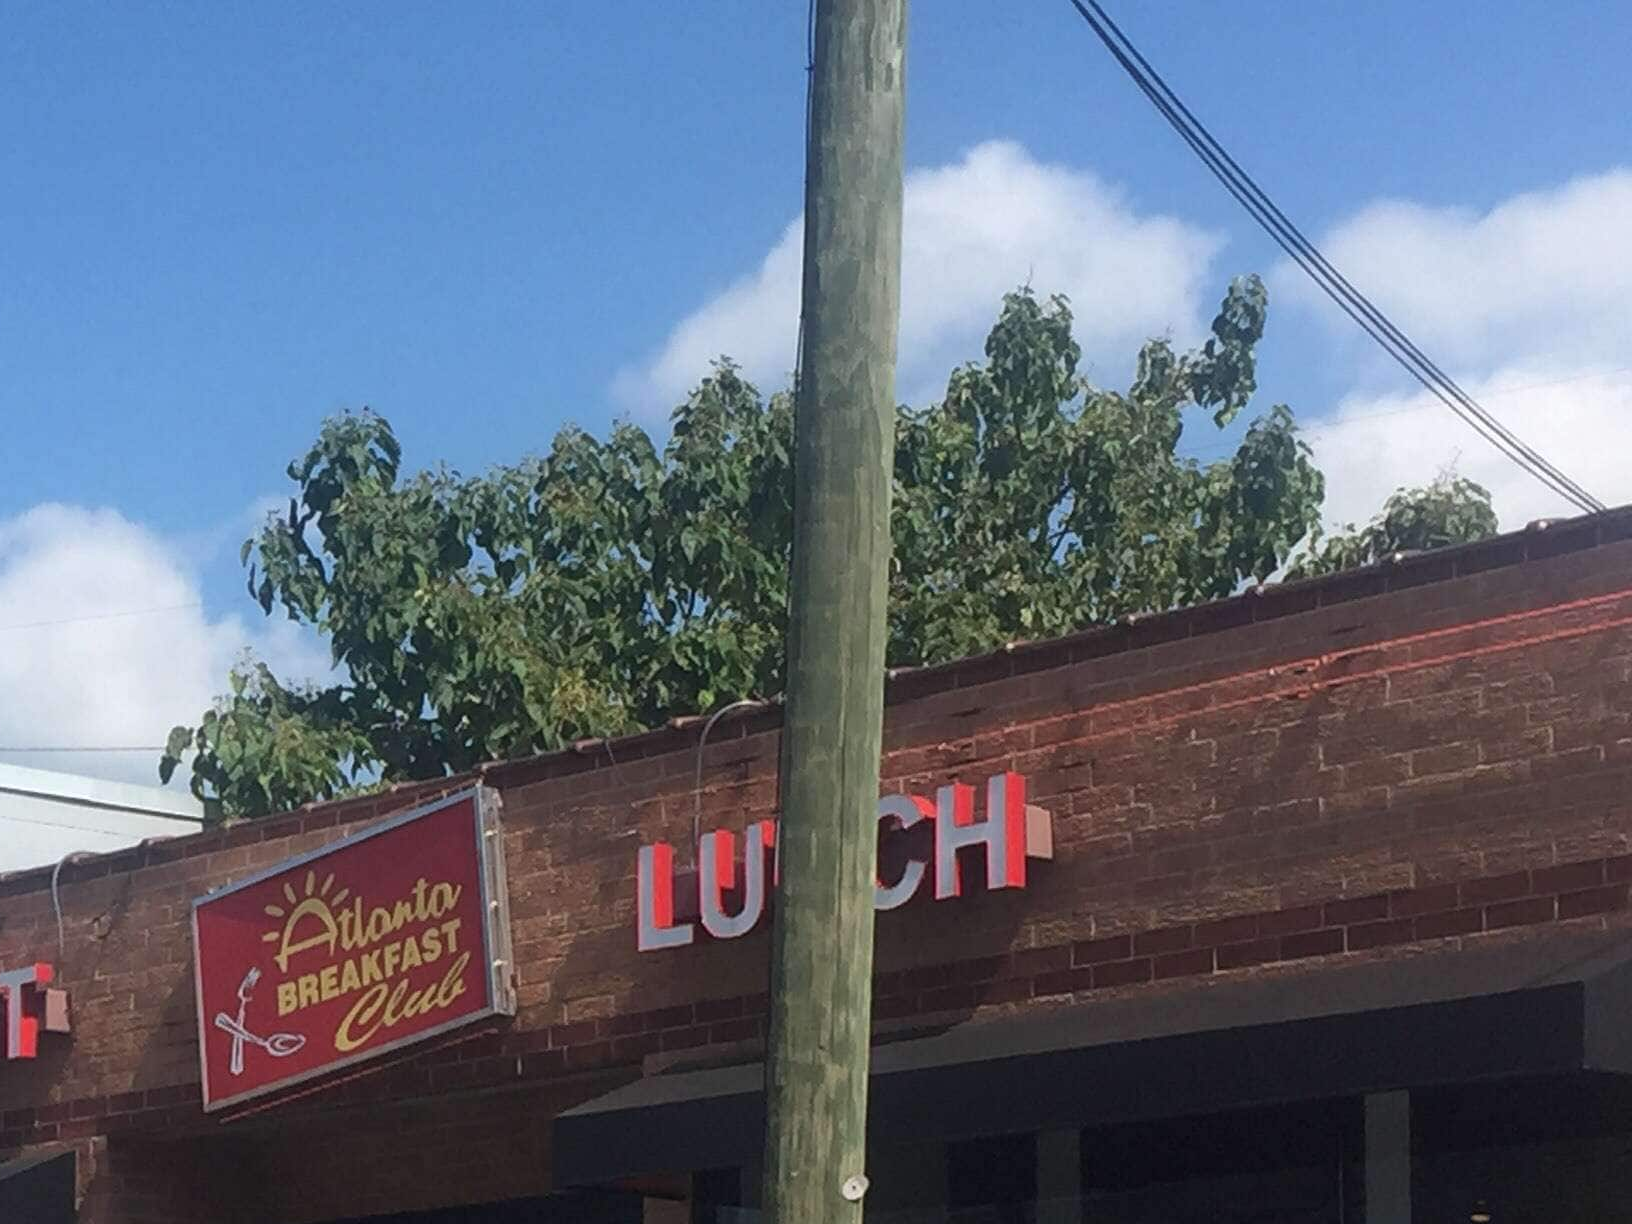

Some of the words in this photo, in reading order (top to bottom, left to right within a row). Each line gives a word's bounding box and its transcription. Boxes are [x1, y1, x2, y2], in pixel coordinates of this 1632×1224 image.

[637, 771, 1026, 953] LUCH
[273, 877, 463, 973] Atlanta
[276, 919, 462, 1017] BREAKFAST
[334, 951, 471, 1052] Club
